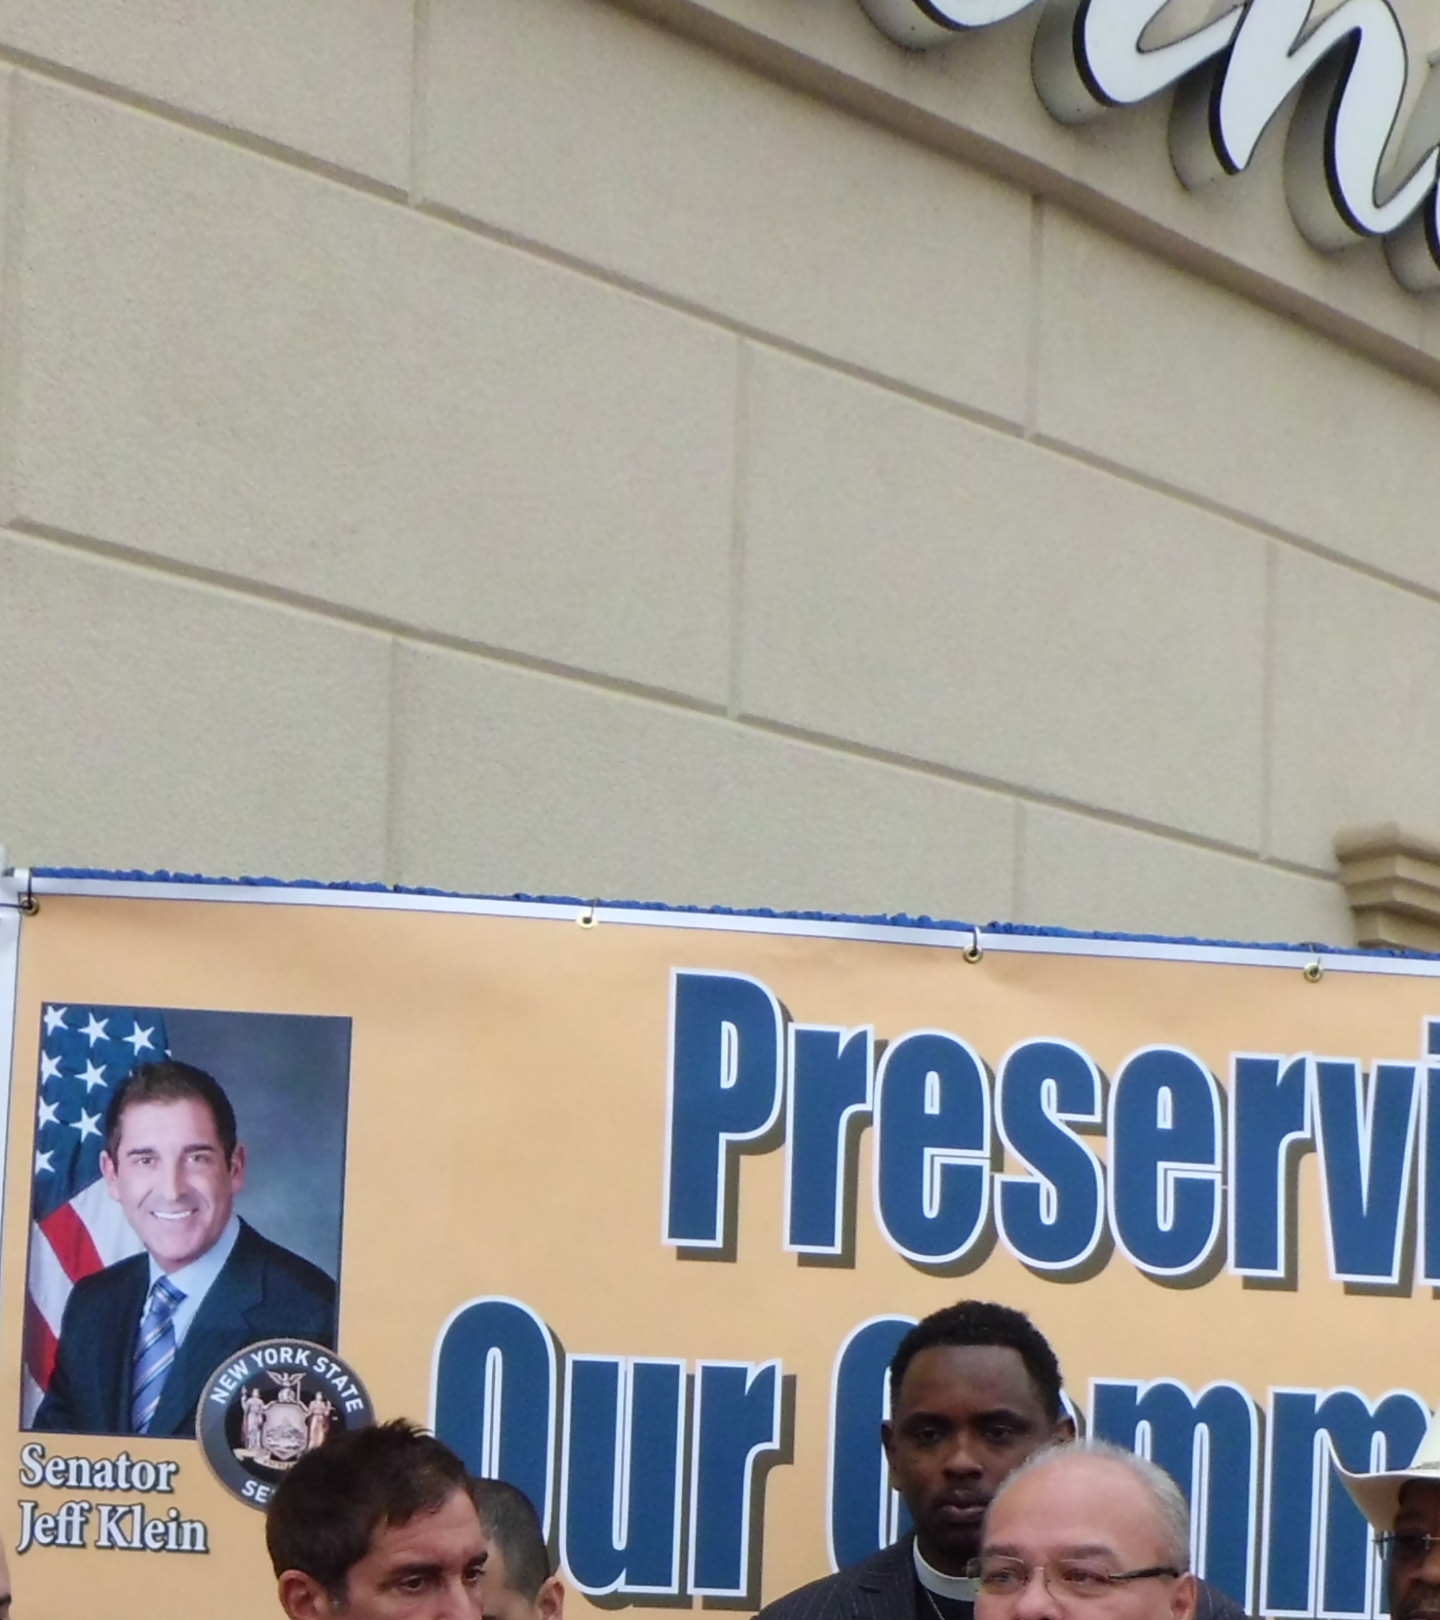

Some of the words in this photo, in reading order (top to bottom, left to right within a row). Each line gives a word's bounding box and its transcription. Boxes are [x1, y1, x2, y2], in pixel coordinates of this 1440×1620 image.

[210, 1358, 250, 1405] NEW
[250, 1346, 311, 1369] YORK
[312, 1356, 365, 1413] STATE
[18, 1443, 179, 1493] Senator
[428, 1294, 784, 1602] Our
[16, 1499, 92, 1554] Jeff
[94, 1503, 210, 1554] Klein
